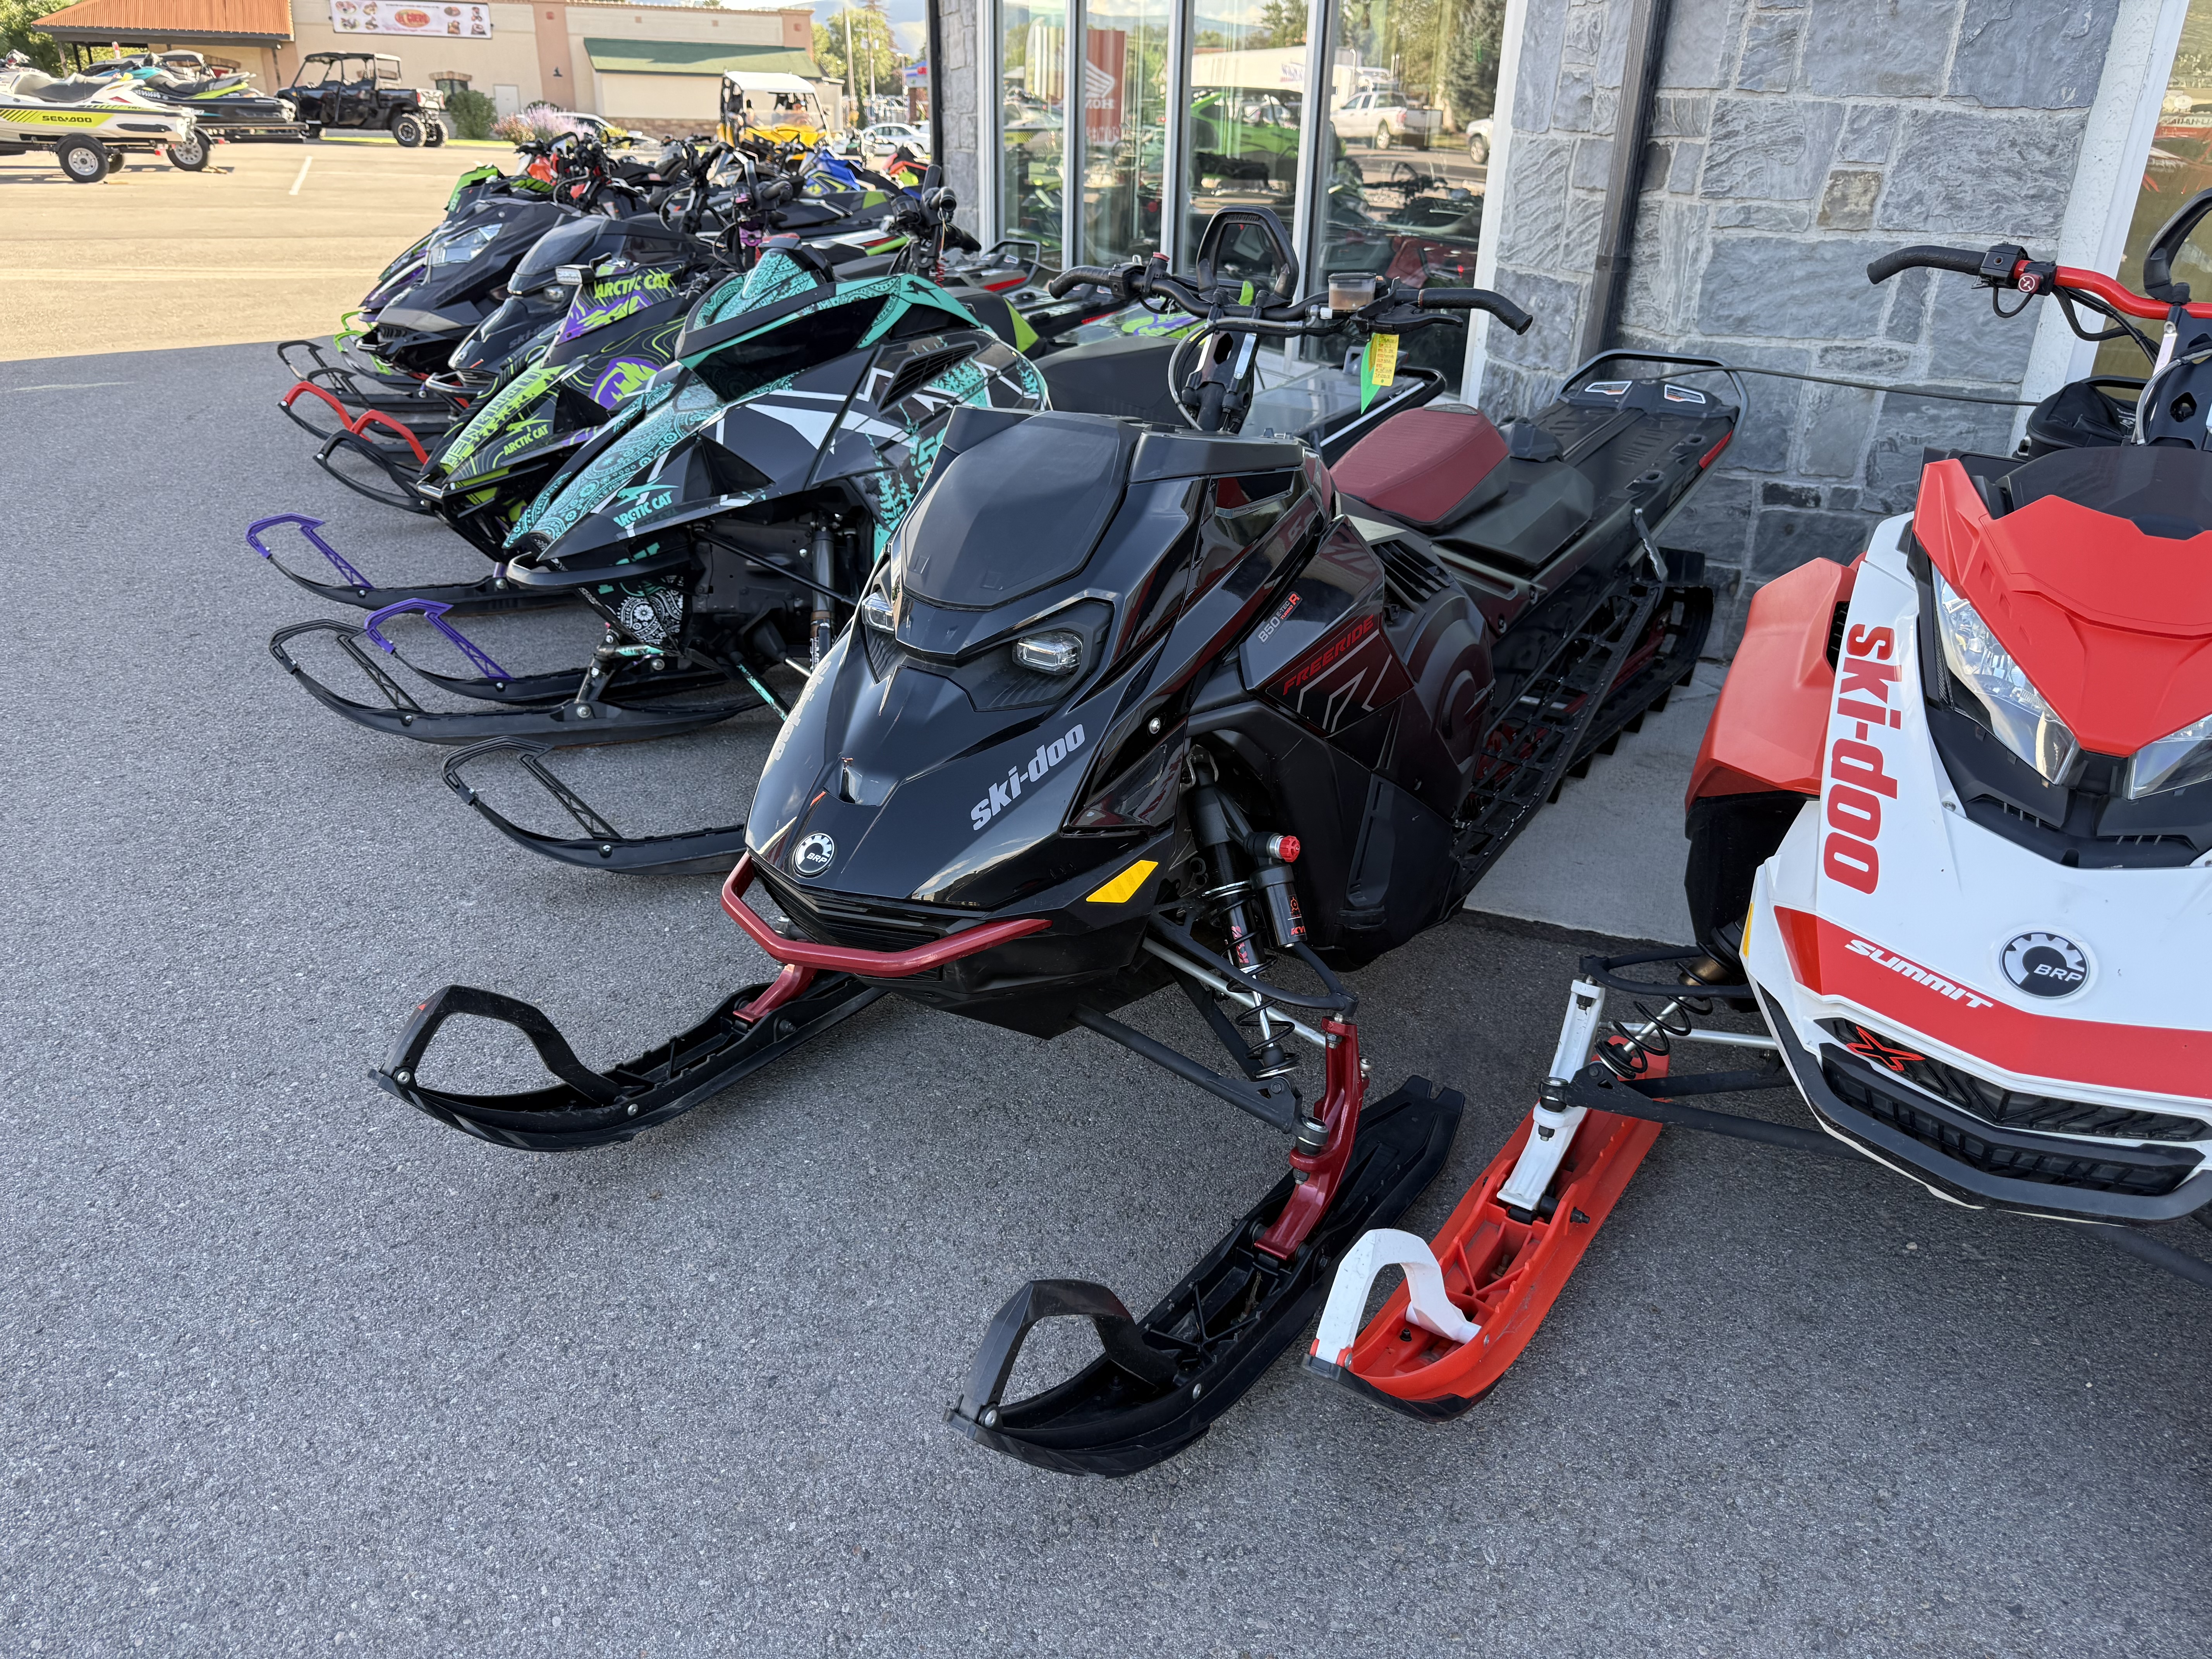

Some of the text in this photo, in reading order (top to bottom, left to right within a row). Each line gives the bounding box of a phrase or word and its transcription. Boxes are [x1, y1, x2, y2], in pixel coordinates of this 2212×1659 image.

[594, 273, 671, 299] ARCTIC CAT
[504, 424, 548, 455] ARCTIC CAT
[652, 491, 672, 509] CAT
[1276, 601, 1290, 617] E-TEC
[1288, 593, 1300, 605] R
[1280, 605, 1293, 620] TURBO
[1258, 617, 1280, 642] 850
[1283, 614, 1374, 696] FREERIDE
[1823, 623, 1902, 895] ski-doo
[970, 723, 1085, 831] ski-doo
[807, 852, 828, 863] BRP
[1291, 926, 1306, 935] KY
[1845, 939, 1994, 1008] SUMMIT
[2033, 963, 2083, 982] BRP
